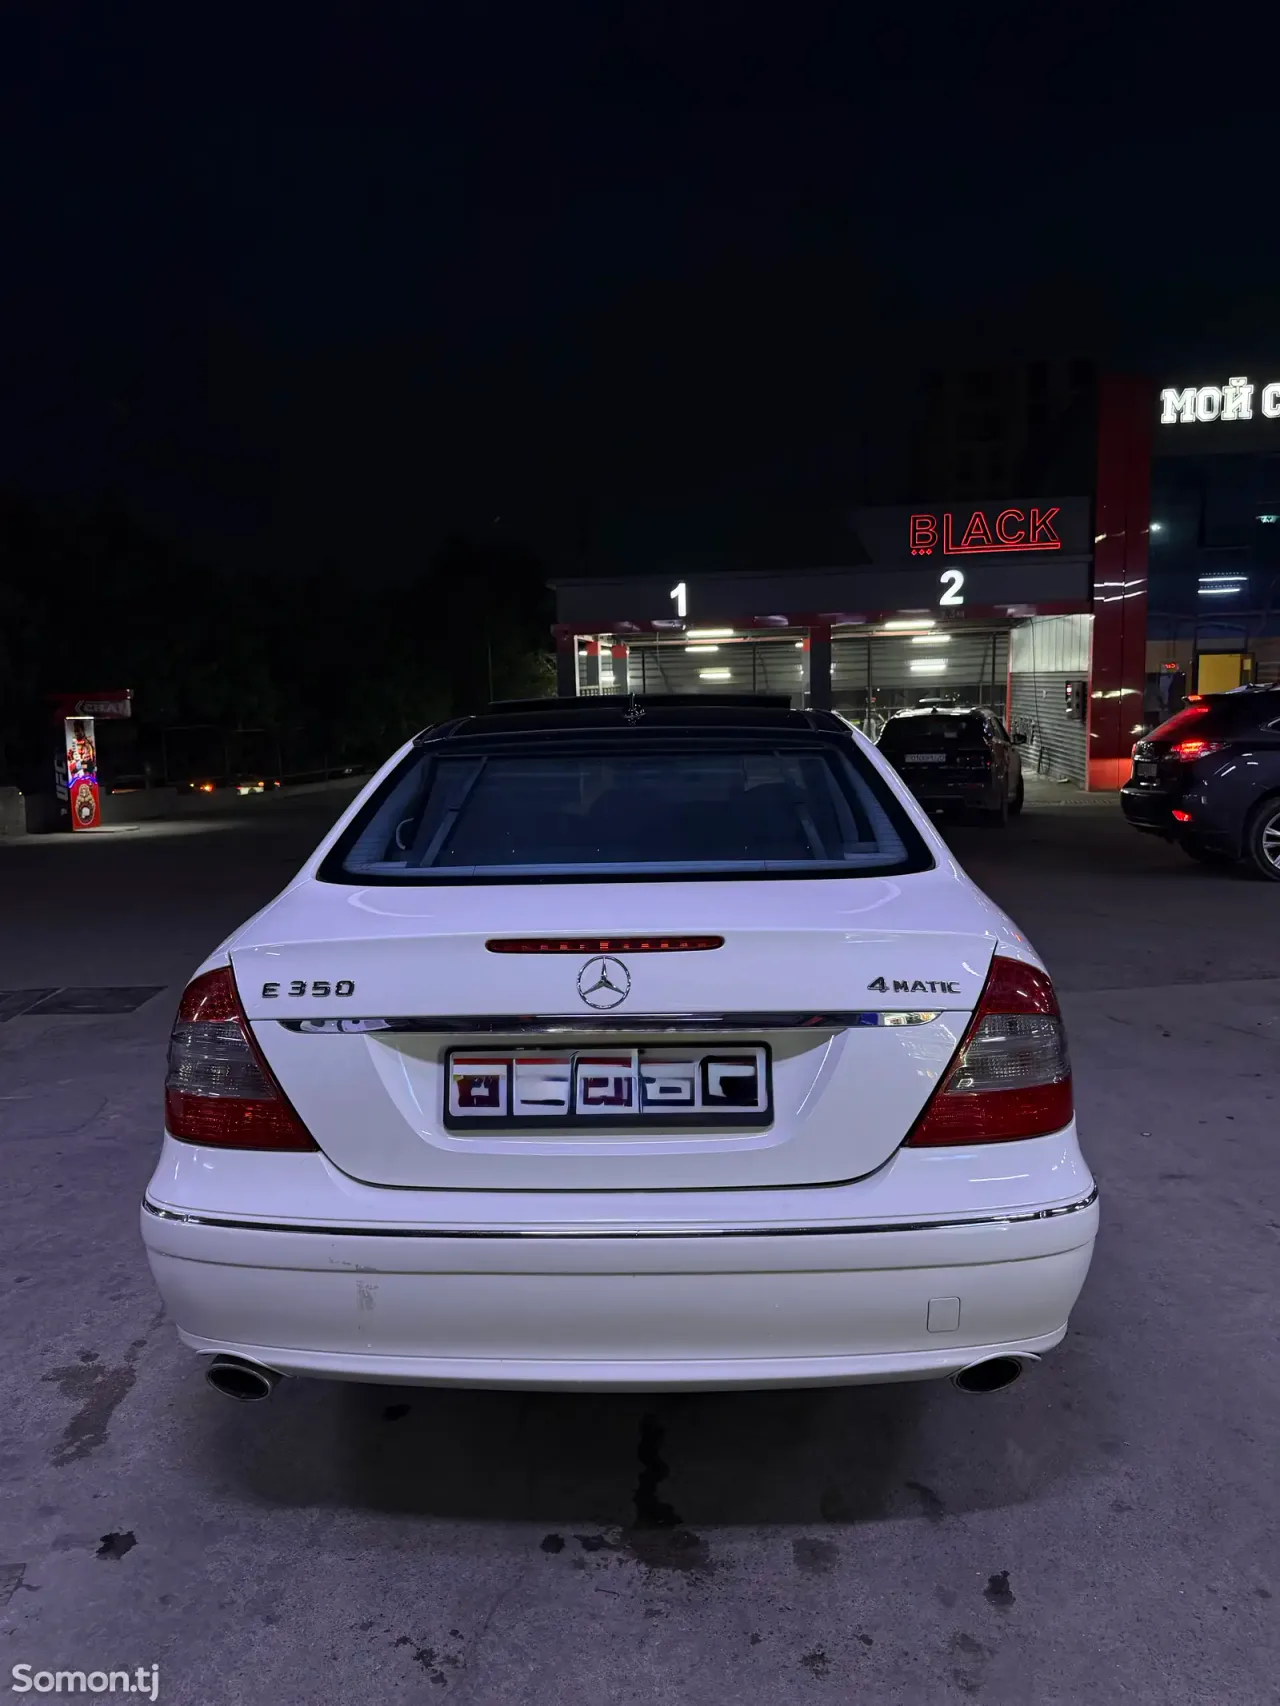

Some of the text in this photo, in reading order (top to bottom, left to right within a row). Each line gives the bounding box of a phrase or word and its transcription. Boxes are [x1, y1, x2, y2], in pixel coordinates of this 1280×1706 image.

[1160, 377, 1254, 424] МОЙ
[910, 508, 1060, 555] BLACK
[670, 583, 686, 617] 1
[940, 570, 964, 606] 2
[54, 758, 69, 801] UFC
[262, 980, 355, 999] E 350
